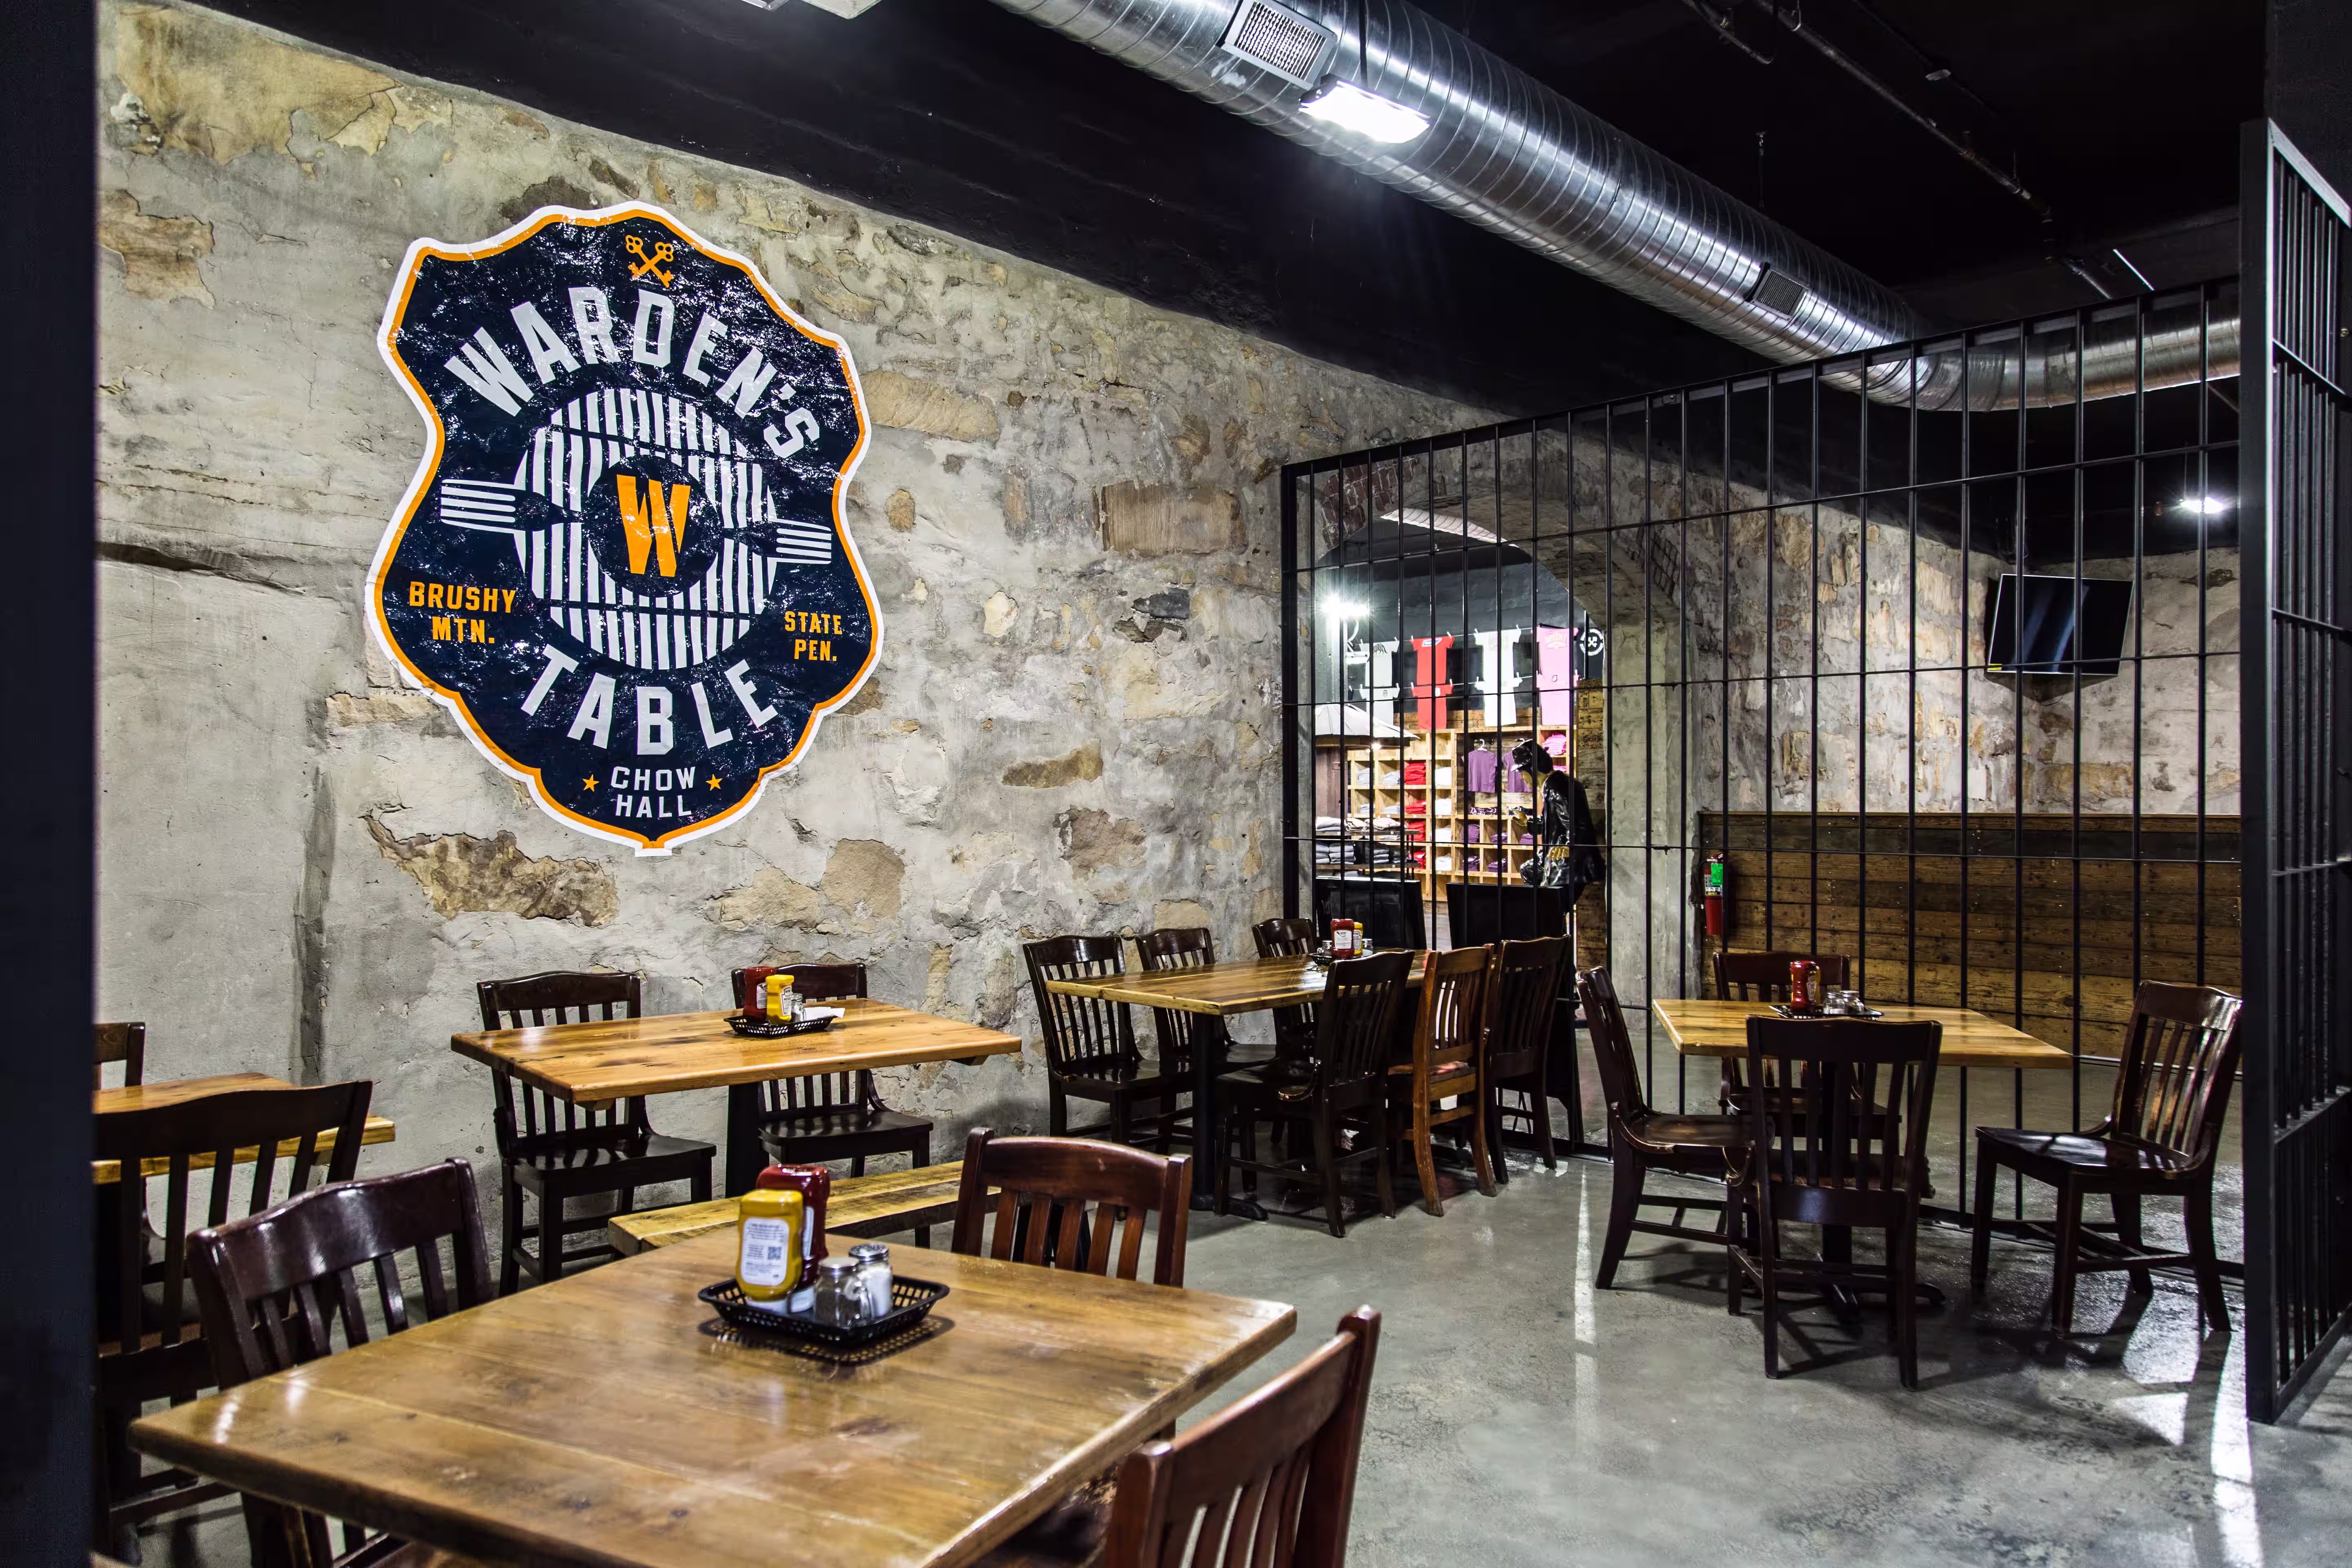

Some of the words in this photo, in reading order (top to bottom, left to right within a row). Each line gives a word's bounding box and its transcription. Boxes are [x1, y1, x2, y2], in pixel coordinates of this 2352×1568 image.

[444, 287, 820, 458] WARDEN'S
[617, 474, 691, 577] W
[409, 581, 516, 613] BRUSHY
[432, 616, 495, 644] MTN.
[784, 611, 843, 635] STATE
[794, 639, 837, 662] PEN.
[521, 644, 778, 755] TABLE
[610, 766, 696, 791] CHOW
[615, 794, 693, 818] HALL
